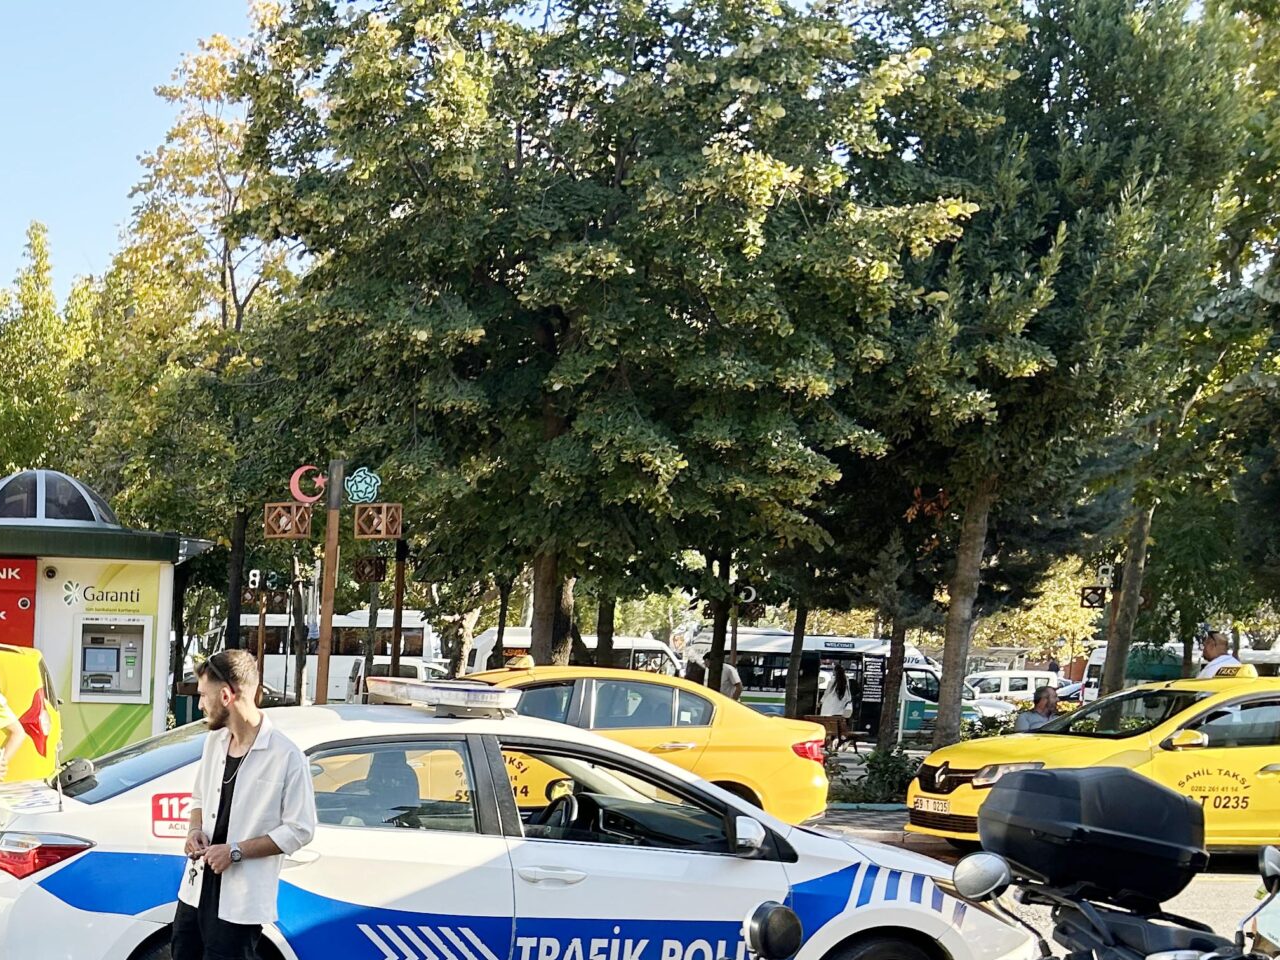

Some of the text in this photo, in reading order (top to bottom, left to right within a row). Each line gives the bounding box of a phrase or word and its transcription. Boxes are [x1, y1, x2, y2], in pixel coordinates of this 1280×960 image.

[83, 586, 140, 603] Garanti
[158, 796, 192, 819] 112
[1213, 795, 1250, 810] 0235
